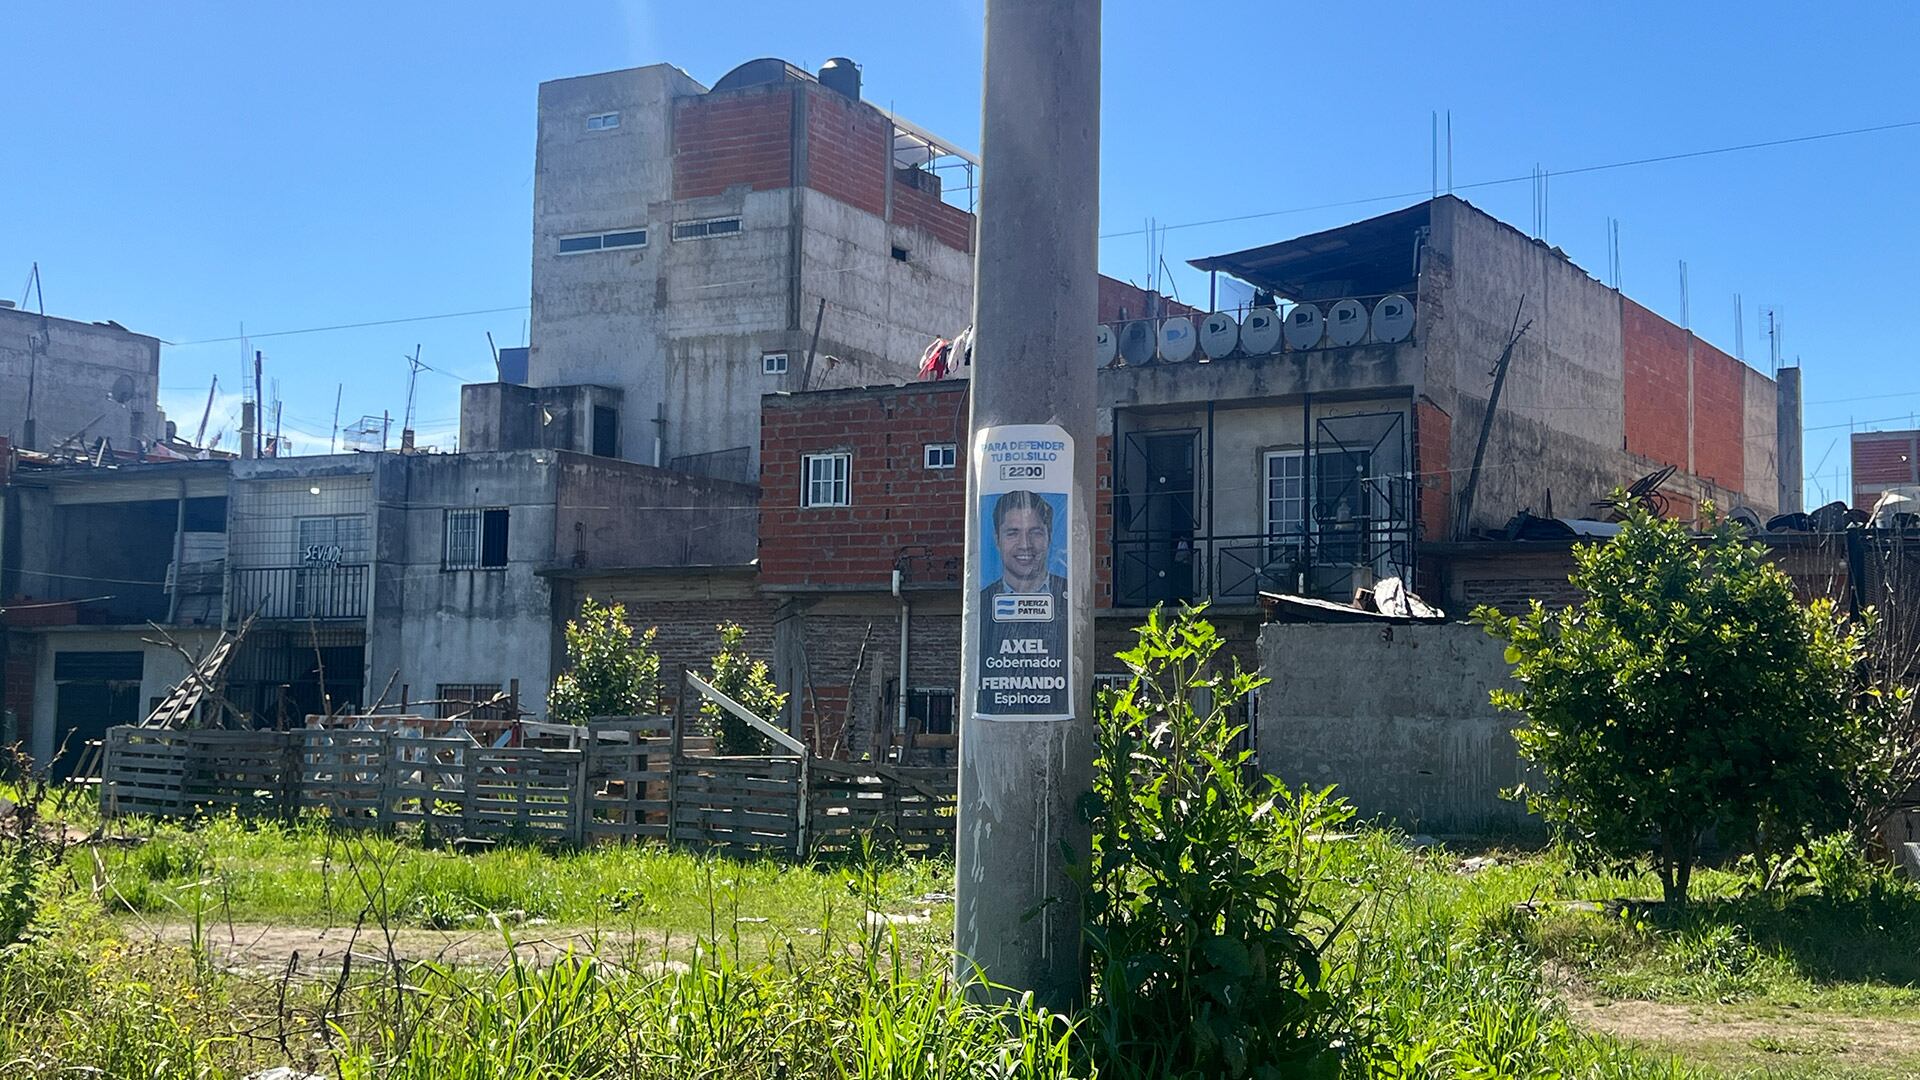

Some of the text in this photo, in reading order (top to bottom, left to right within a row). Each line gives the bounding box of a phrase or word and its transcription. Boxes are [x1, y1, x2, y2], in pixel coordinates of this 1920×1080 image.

[981, 441, 1064, 452] PARA DEFENDER
[991, 452, 1057, 462] TU BOLSILLO
[1009, 466, 1042, 476] 2200
[1000, 639, 1048, 653] AXEL
[986, 657, 1061, 668] Gobernador
[982, 676, 1065, 689] FERNANDO
[995, 692, 1050, 706] Espinoza
